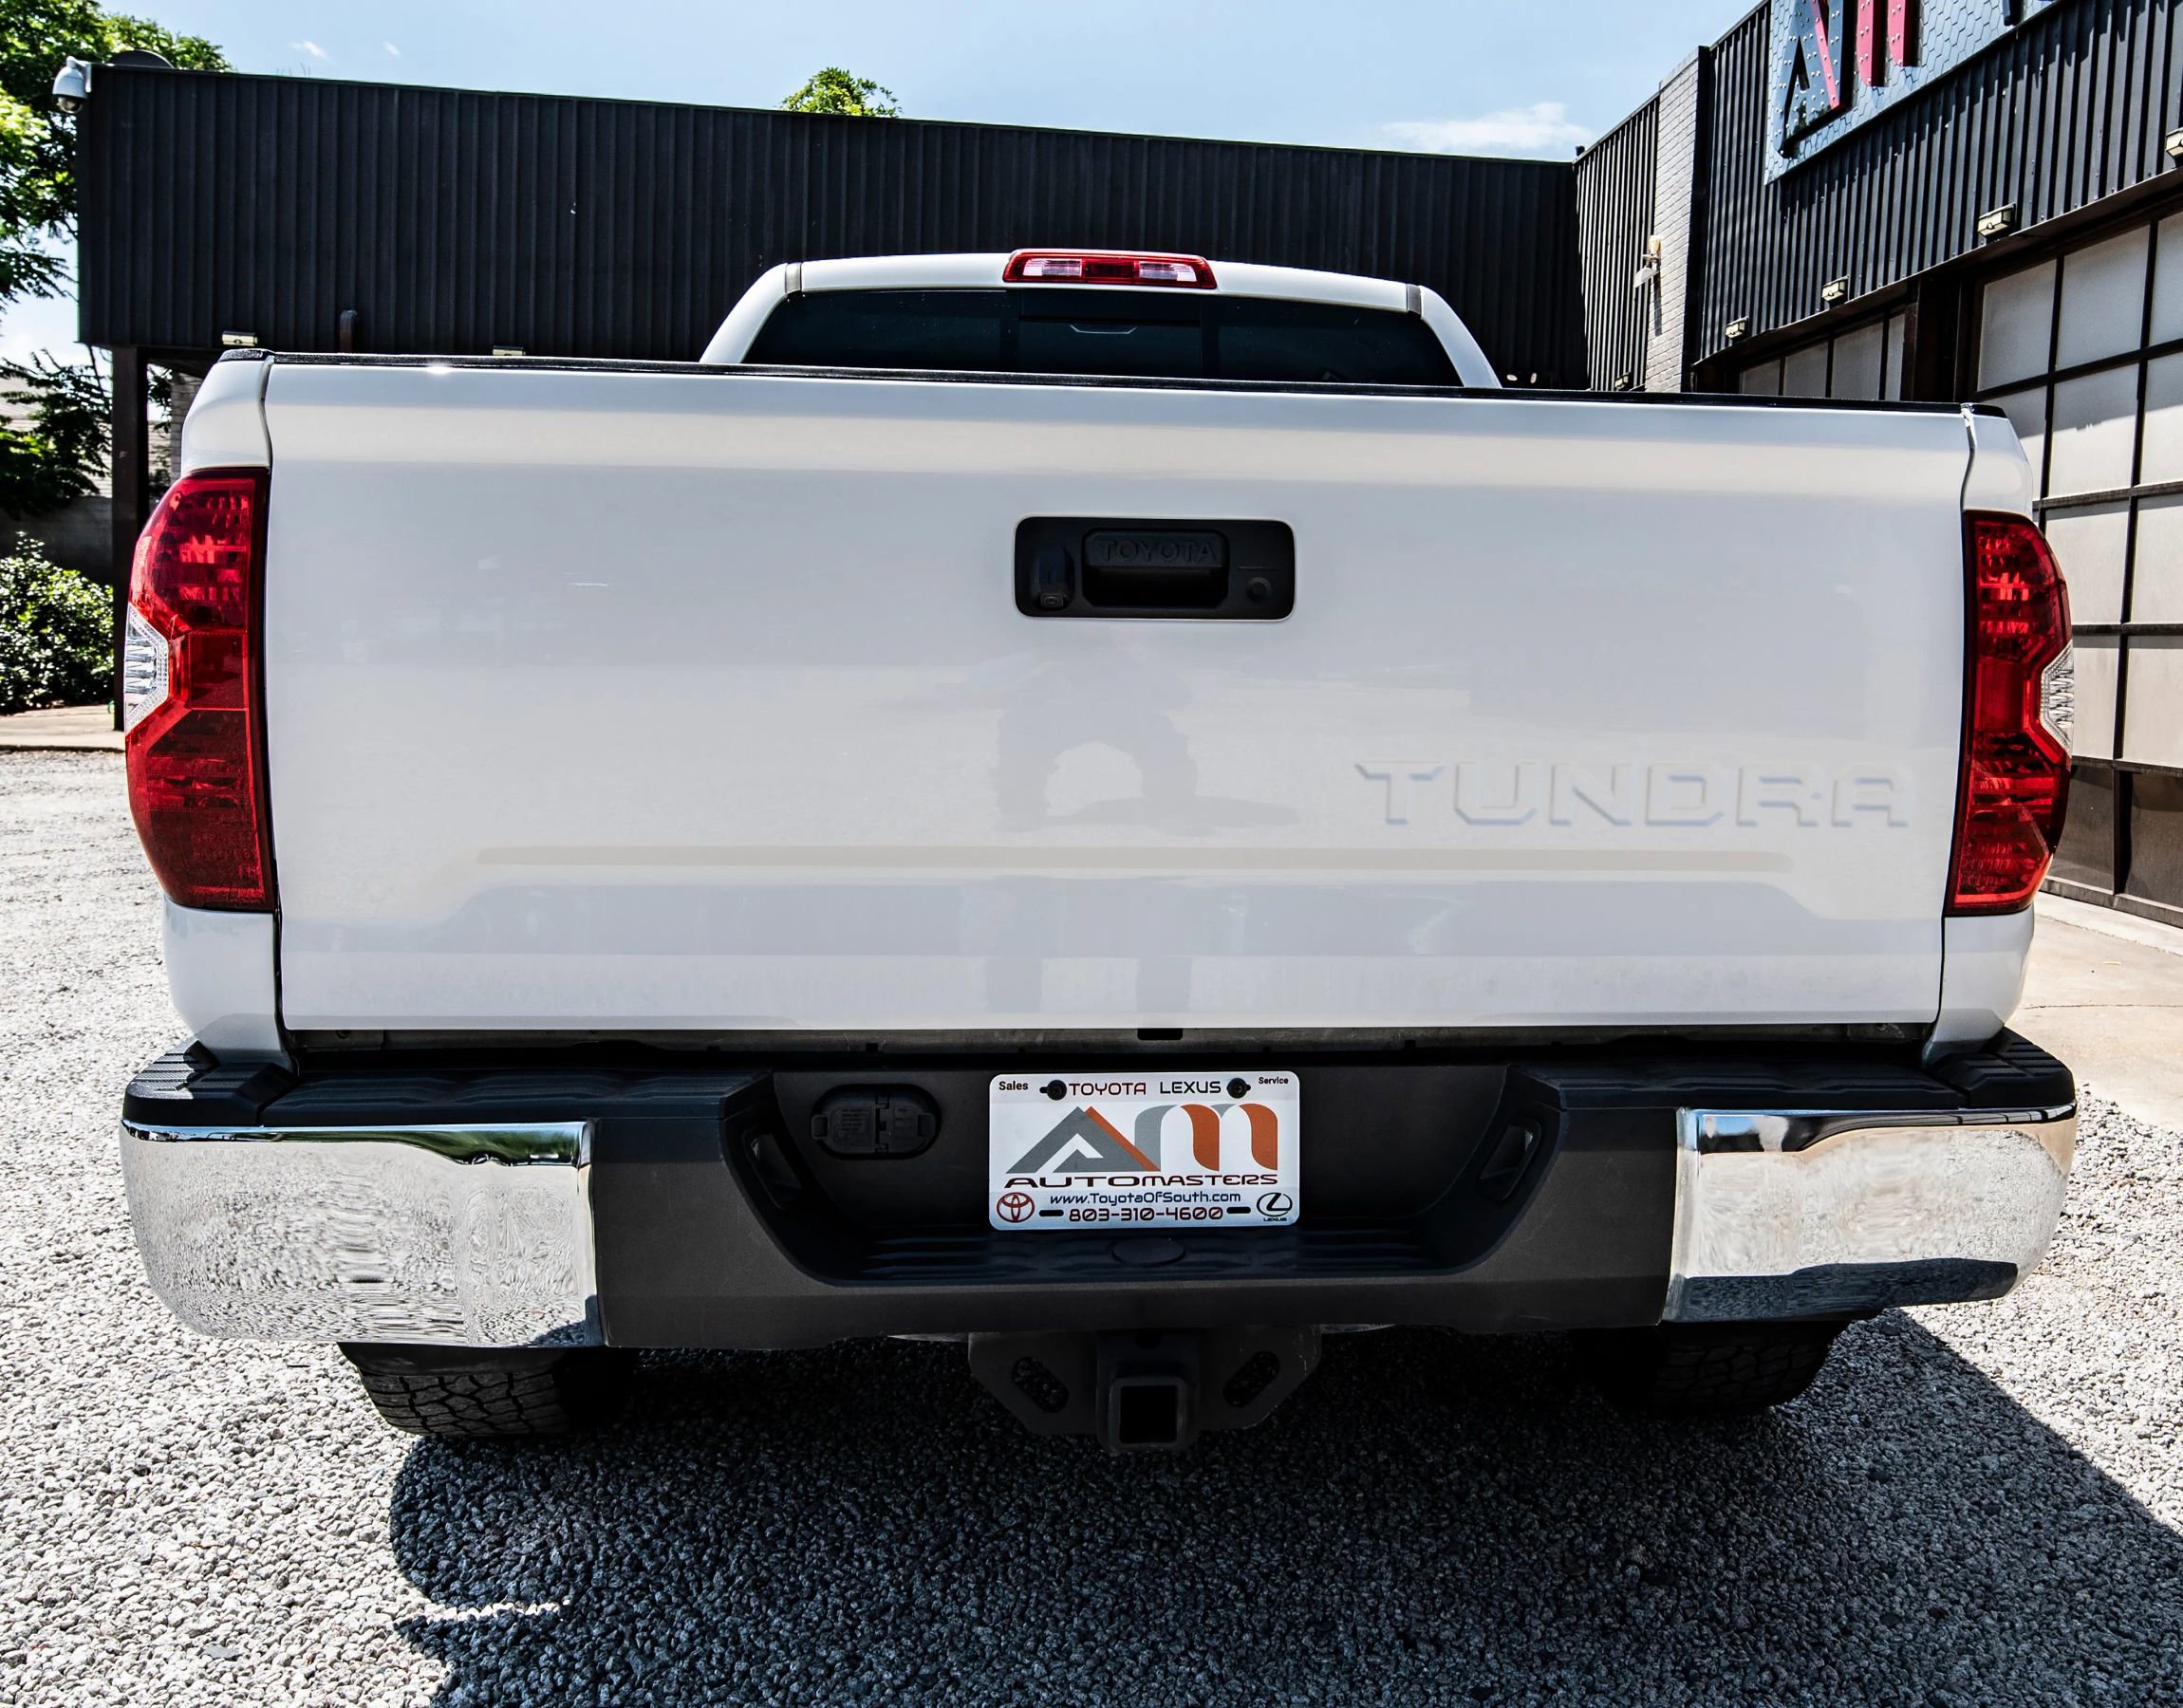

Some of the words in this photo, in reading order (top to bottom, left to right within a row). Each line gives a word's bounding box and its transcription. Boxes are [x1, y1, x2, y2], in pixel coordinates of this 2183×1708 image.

[1099, 539, 1218, 563] TOYOTA
[1354, 761, 1911, 827] TUNDRA
[998, 1081, 1029, 1090] Sales
[1259, 1076, 1289, 1085] Service
[1069, 1082, 1147, 1096] TOYOTA
[1160, 1081, 1222, 1094] LEXUS
[1004, 1174, 1278, 1189] AUTOMASTERS
[1069, 1206, 1223, 1222] 803-310-4600
